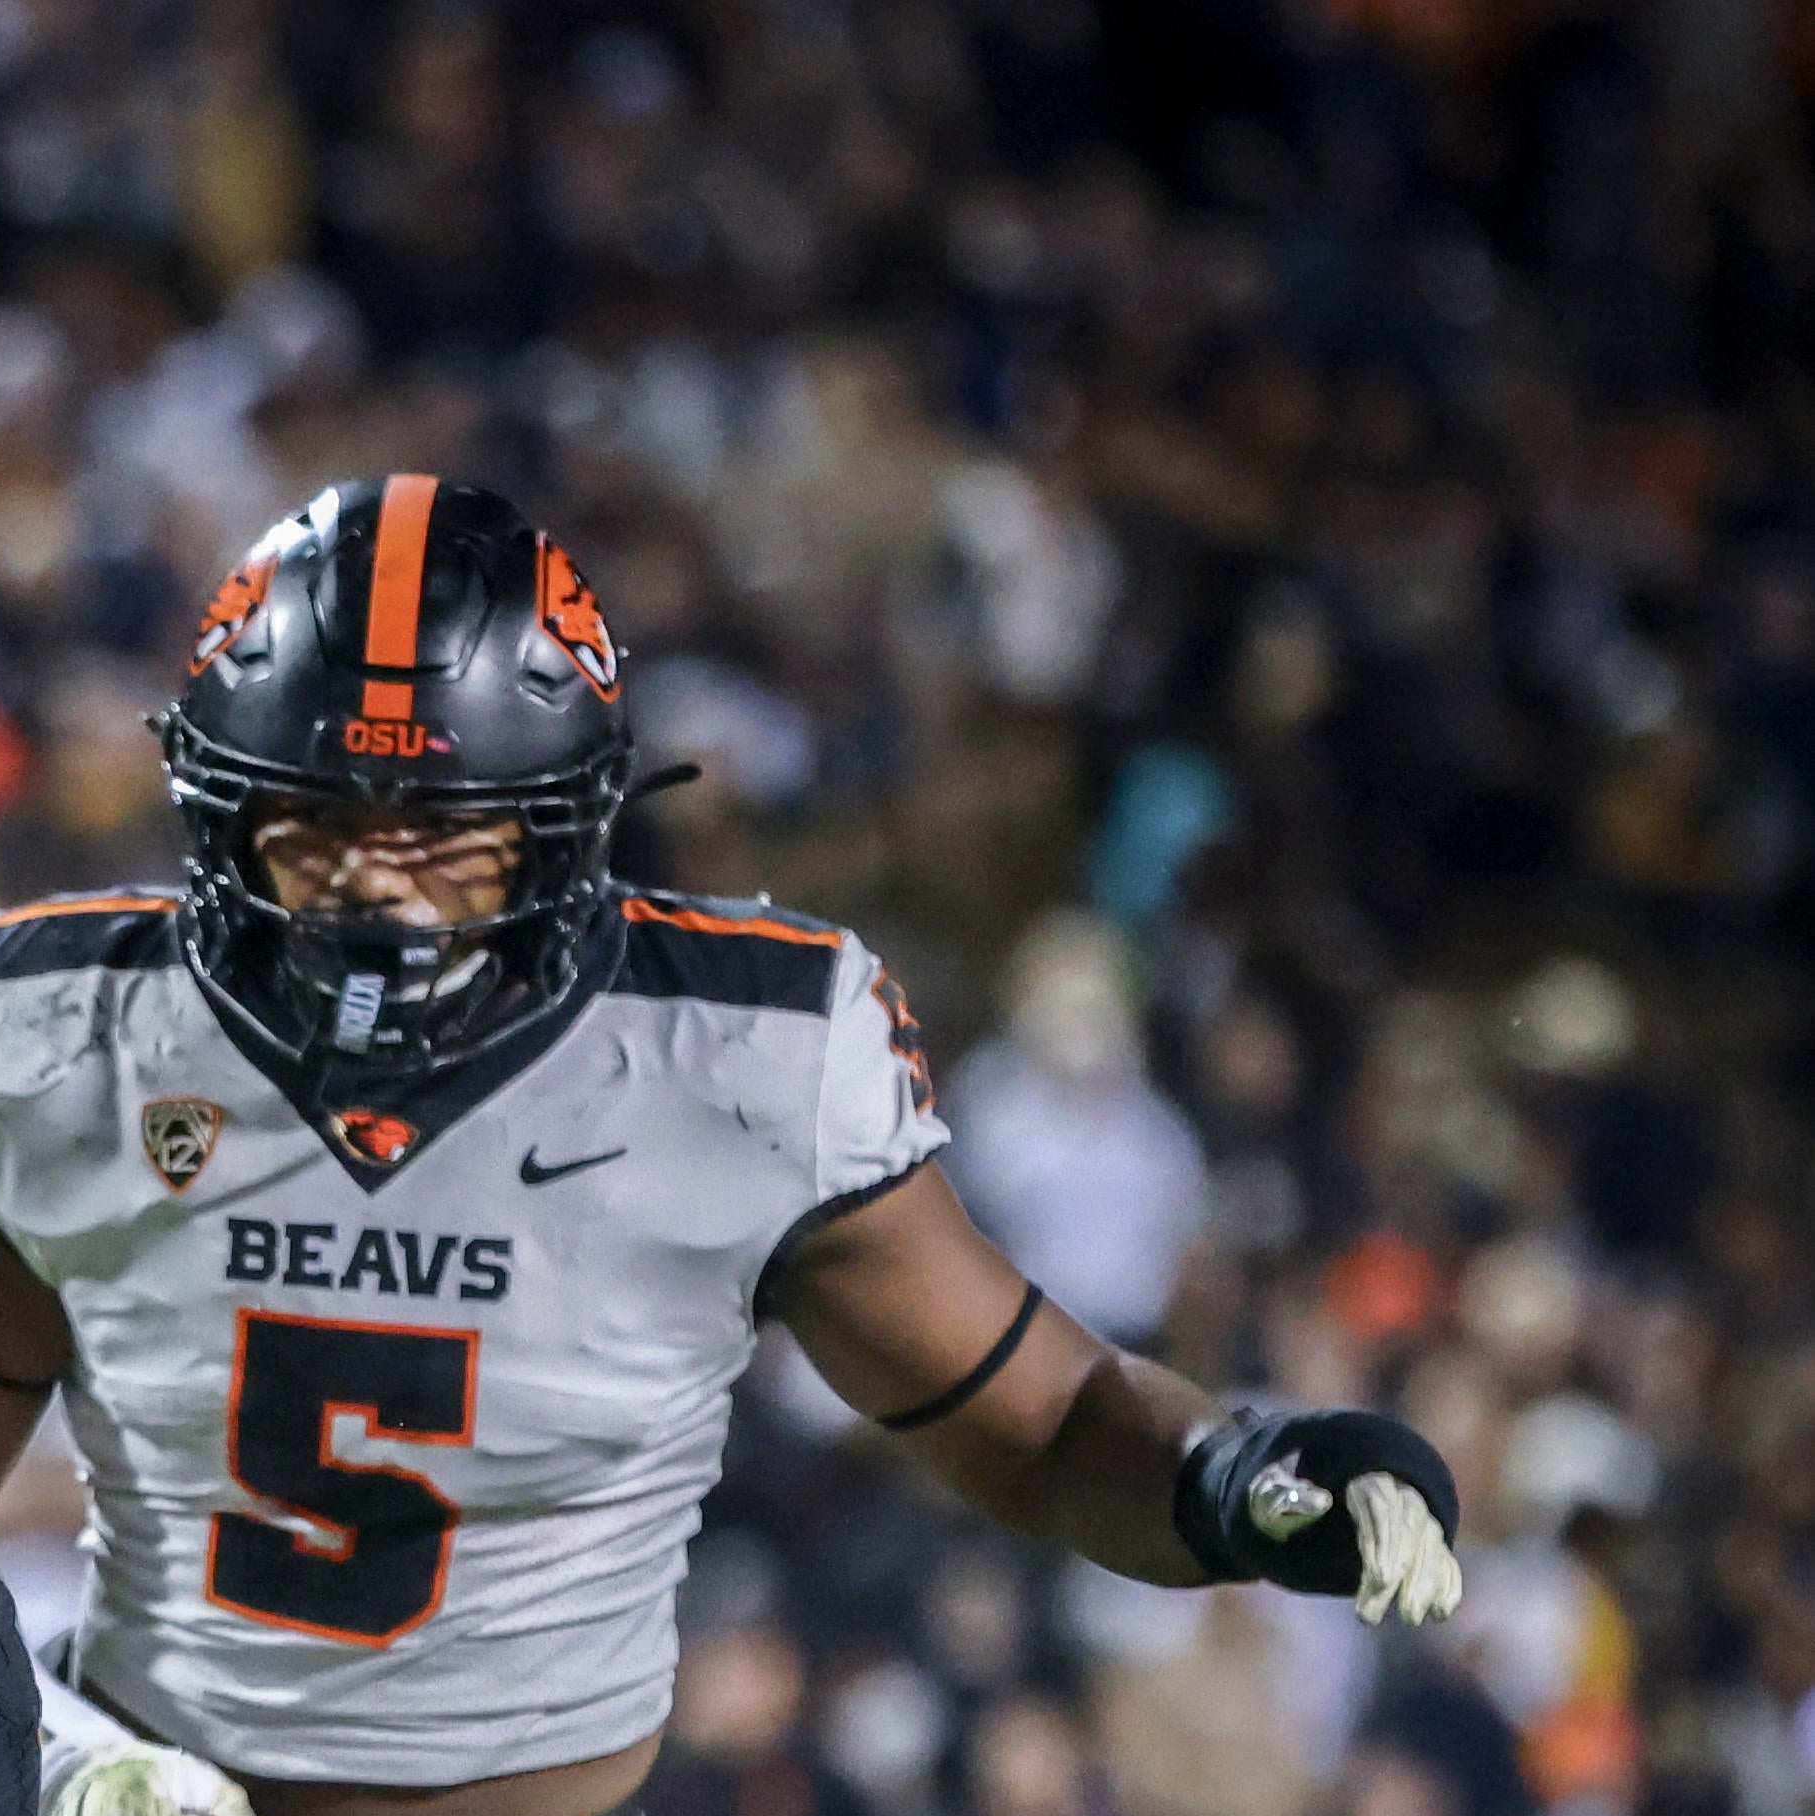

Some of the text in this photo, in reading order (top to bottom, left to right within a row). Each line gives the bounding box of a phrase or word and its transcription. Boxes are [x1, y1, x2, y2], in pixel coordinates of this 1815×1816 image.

[343, 718, 428, 758] OSU
[225, 1216, 514, 1301] BEAVS
[203, 1305, 482, 1650] 5
